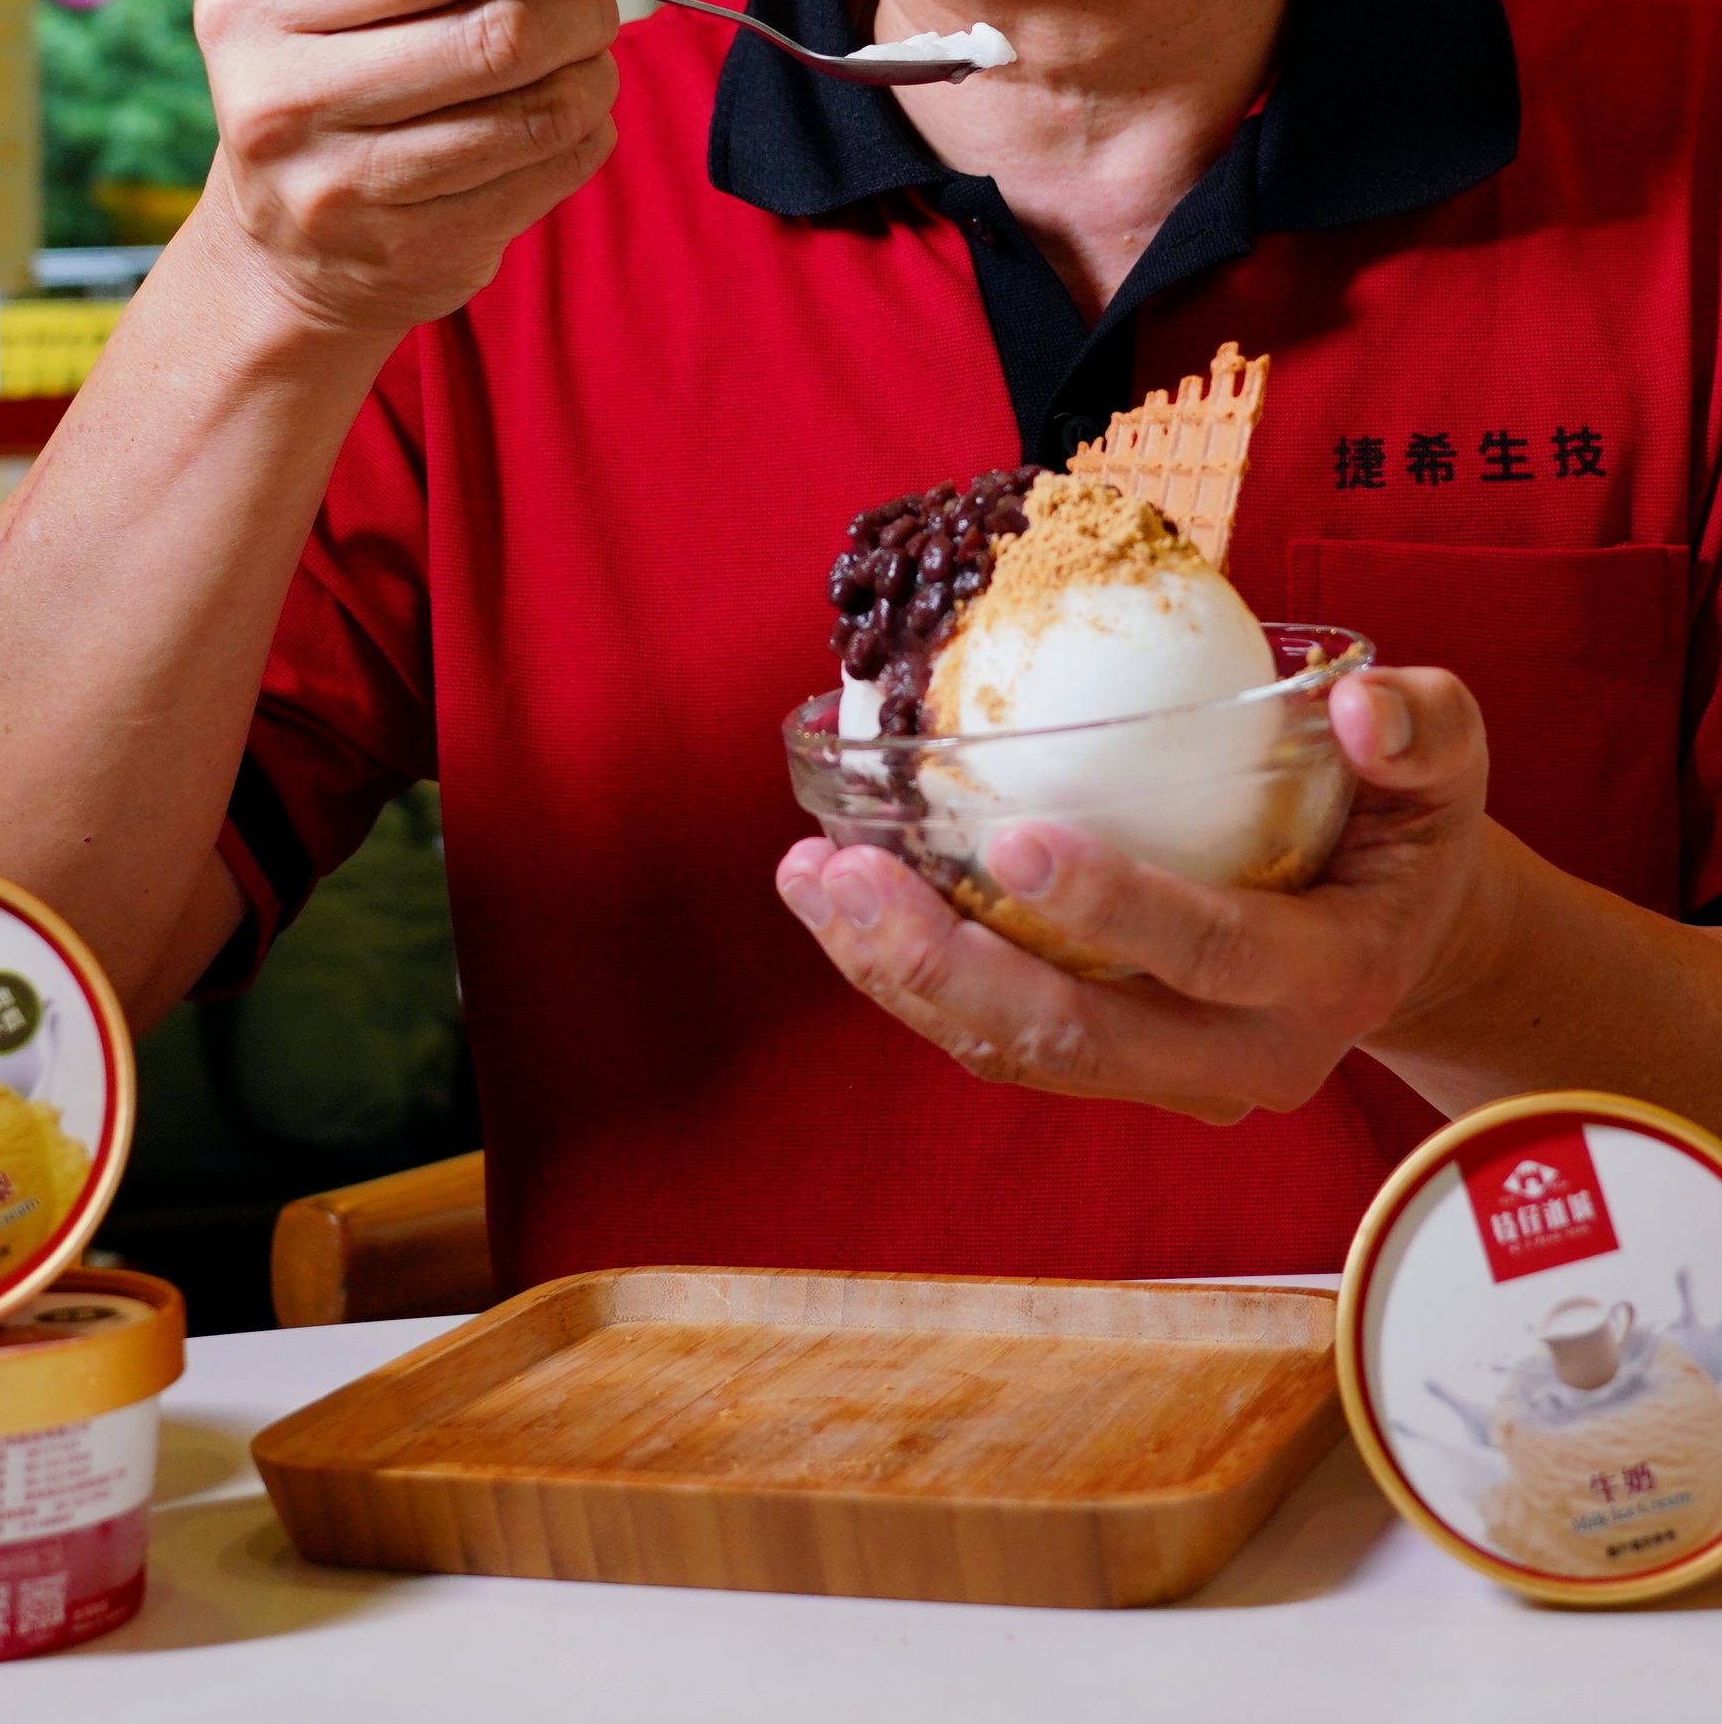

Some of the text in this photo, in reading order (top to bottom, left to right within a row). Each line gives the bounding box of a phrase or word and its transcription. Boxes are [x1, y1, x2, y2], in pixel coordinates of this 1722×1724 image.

[1333, 426, 1607, 489] 捷希生技
[1590, 1461, 1657, 1502] 牛奶
